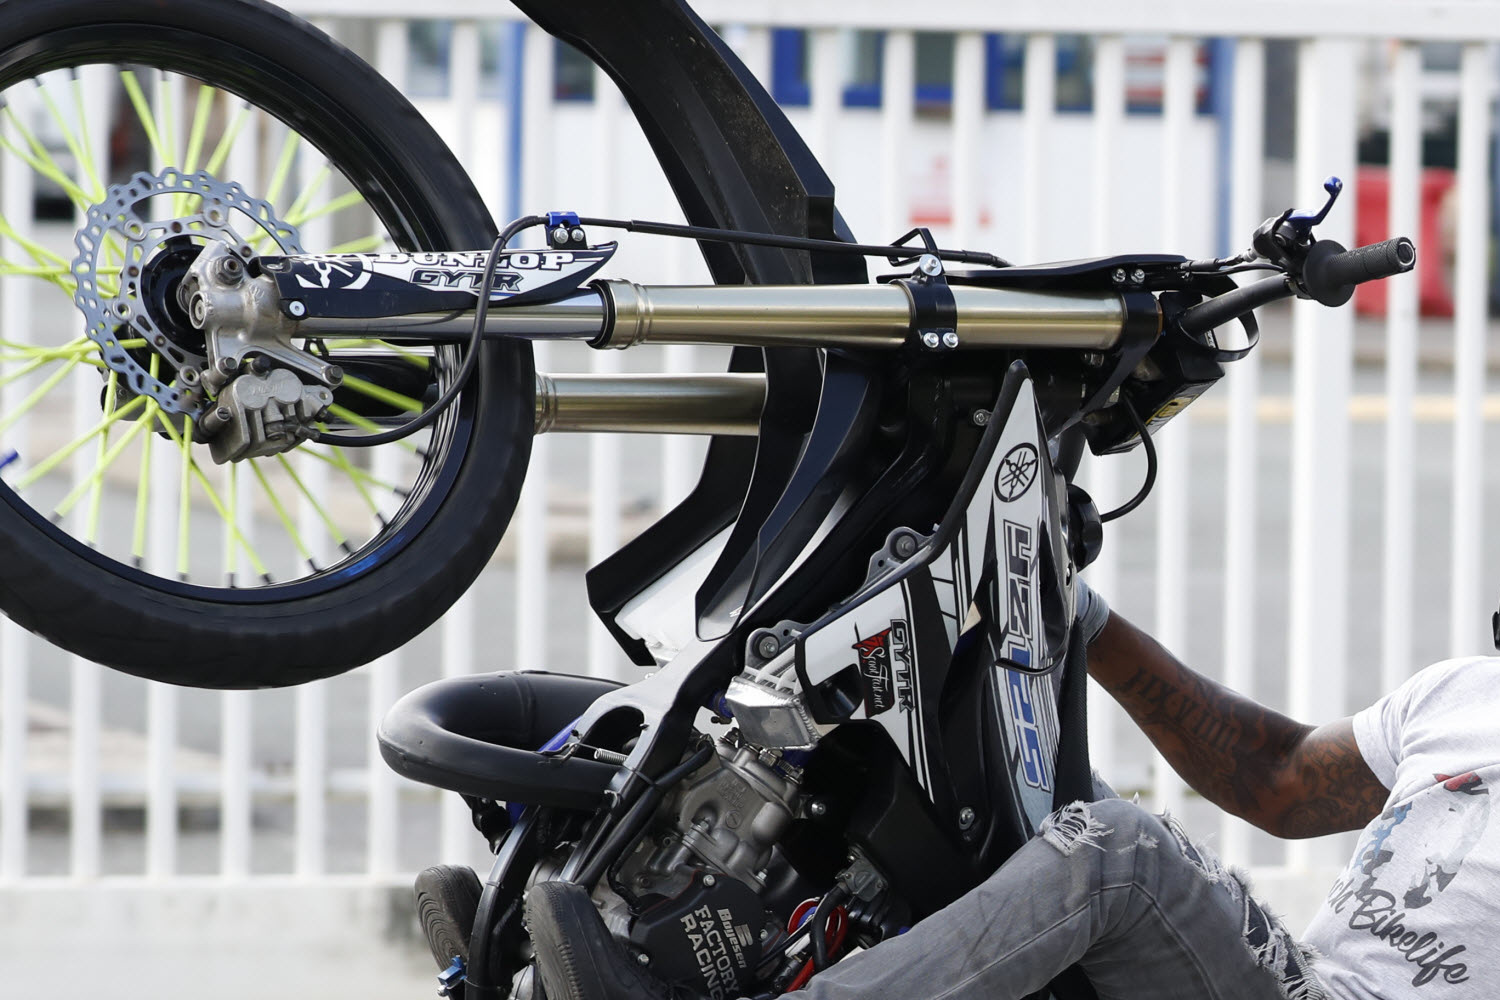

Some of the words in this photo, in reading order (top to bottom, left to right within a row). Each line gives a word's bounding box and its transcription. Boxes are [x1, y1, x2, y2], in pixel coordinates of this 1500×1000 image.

[890, 619, 915, 713] GYTR
[680, 913, 724, 1000] RACING
[694, 904, 739, 993] FACTORY
[717, 908, 747, 968] Boyesen
[1349, 888, 1470, 987] Bikelife
